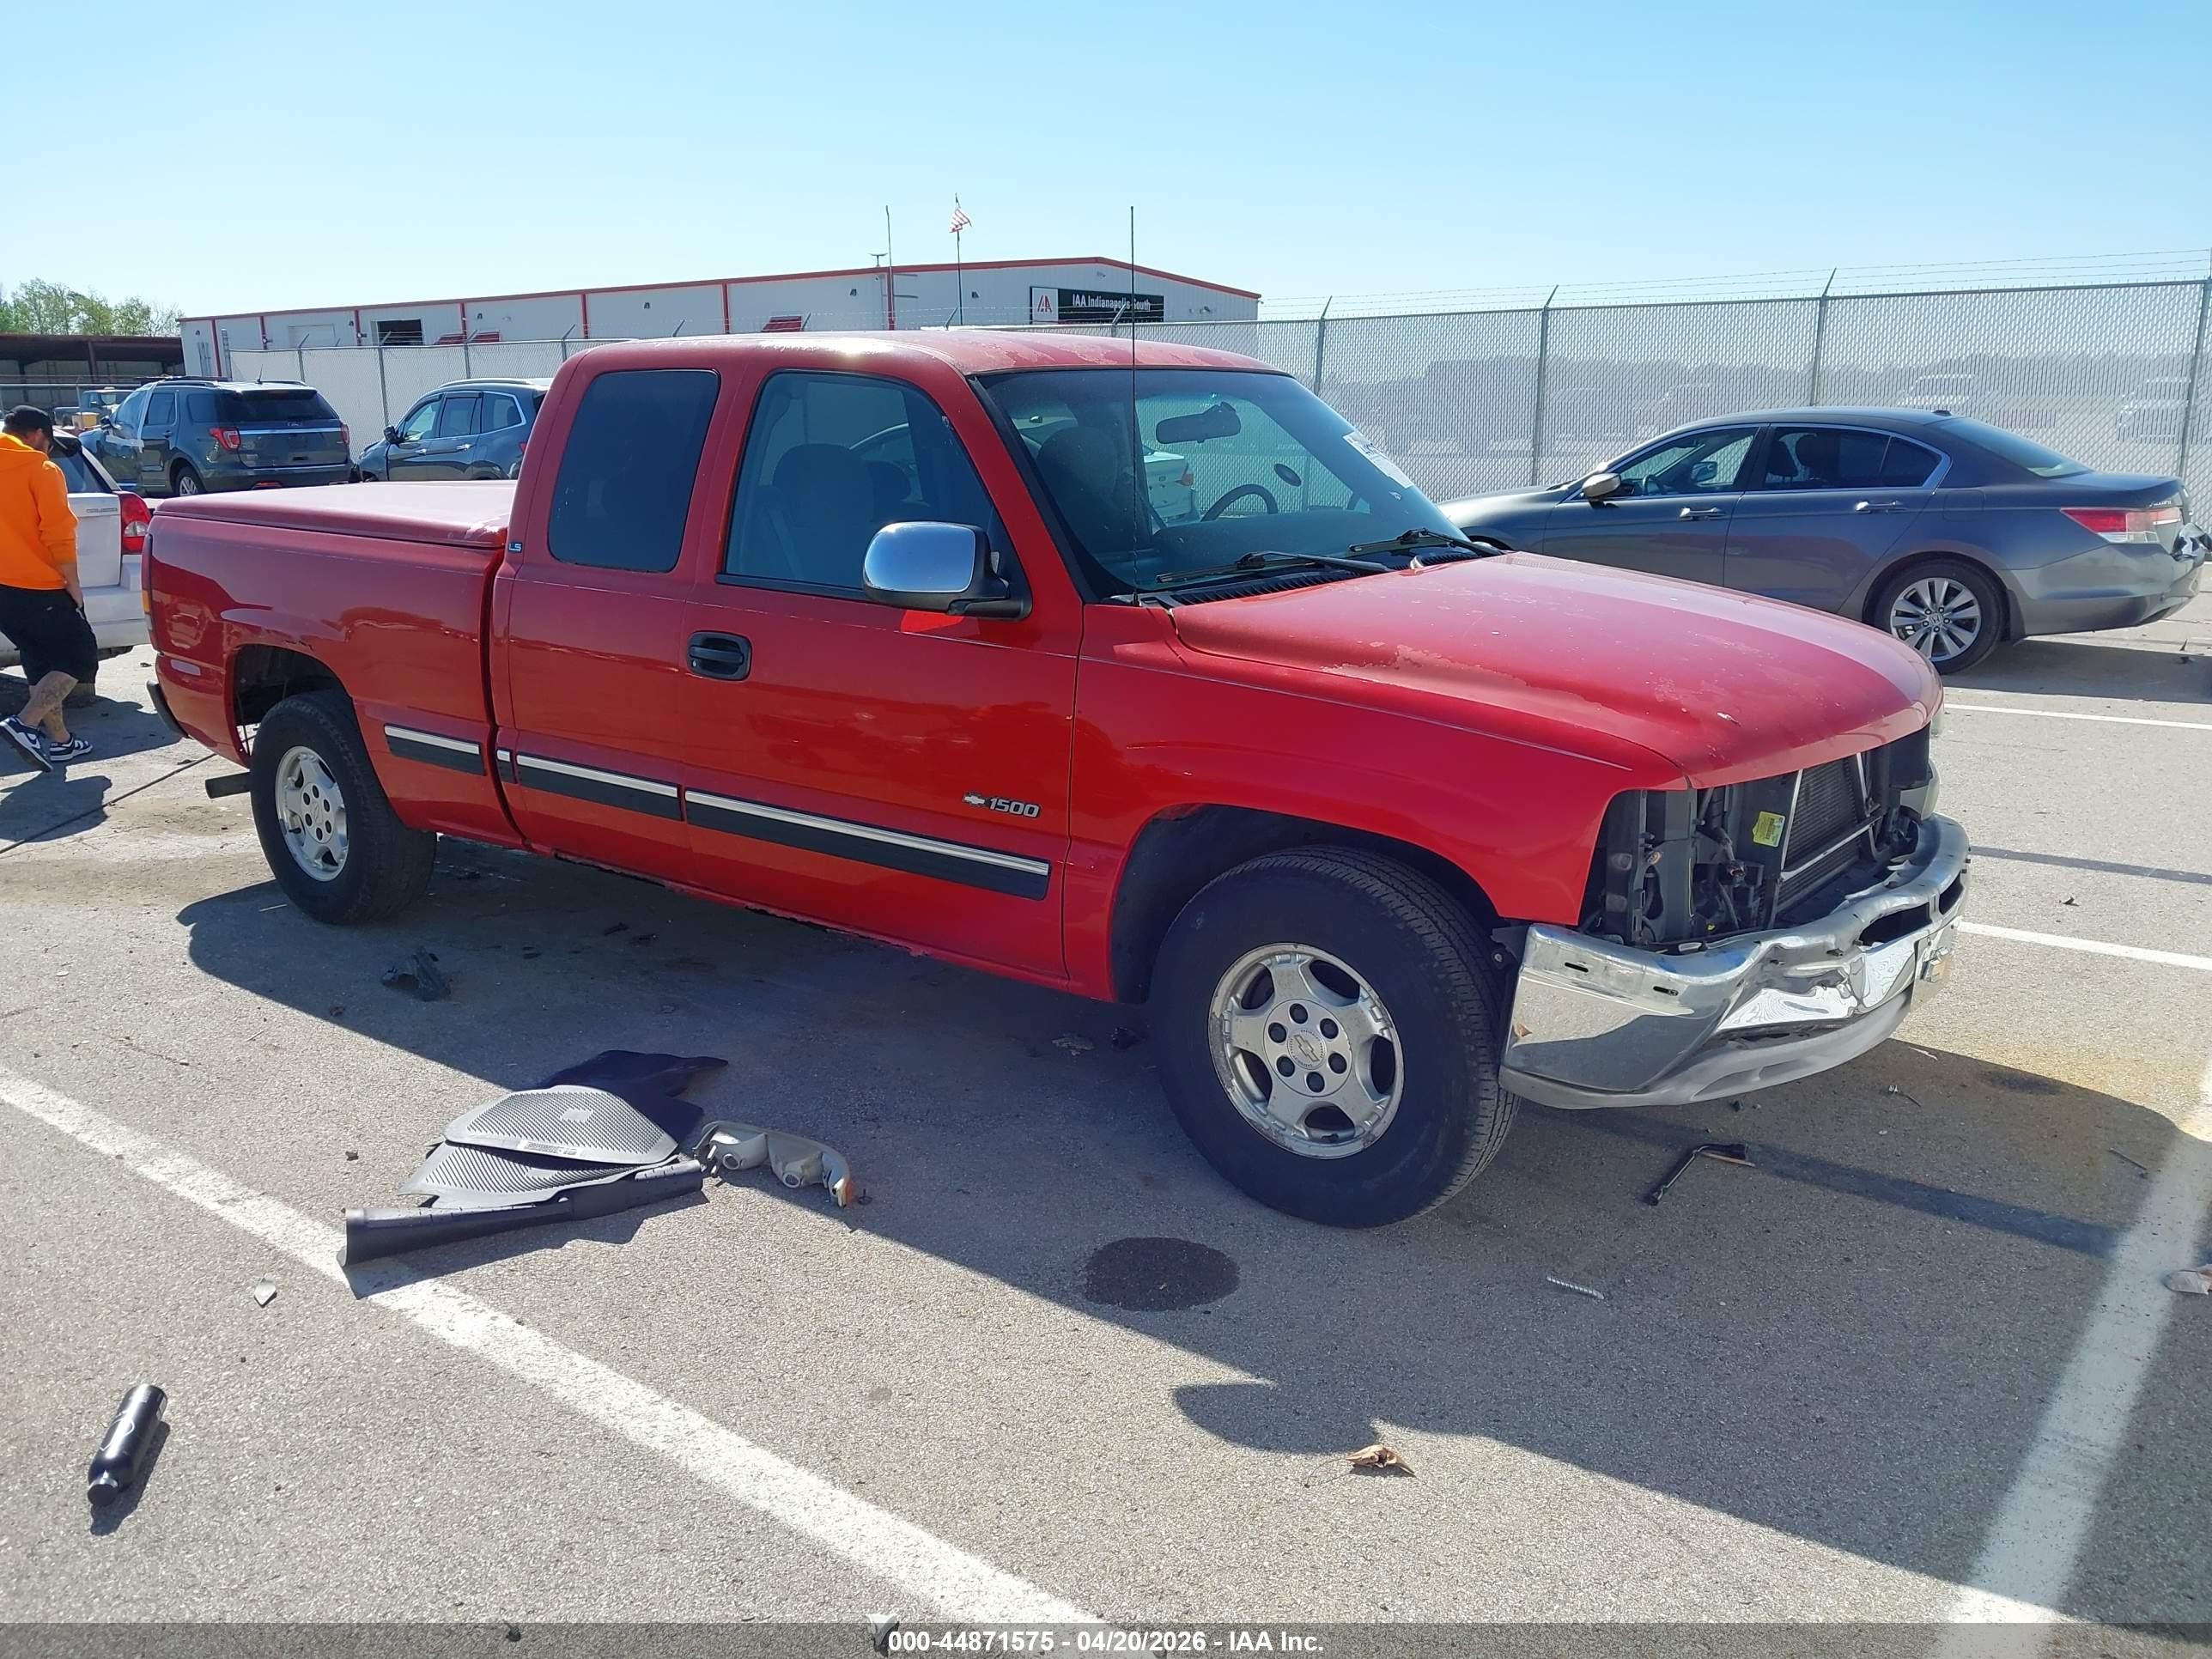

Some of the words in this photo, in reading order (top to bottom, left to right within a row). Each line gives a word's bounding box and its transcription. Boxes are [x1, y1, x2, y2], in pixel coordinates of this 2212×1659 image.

[1073, 294, 1086, 307] IAA
[508, 542, 522, 552] LS
[989, 797, 1041, 818] 1500
